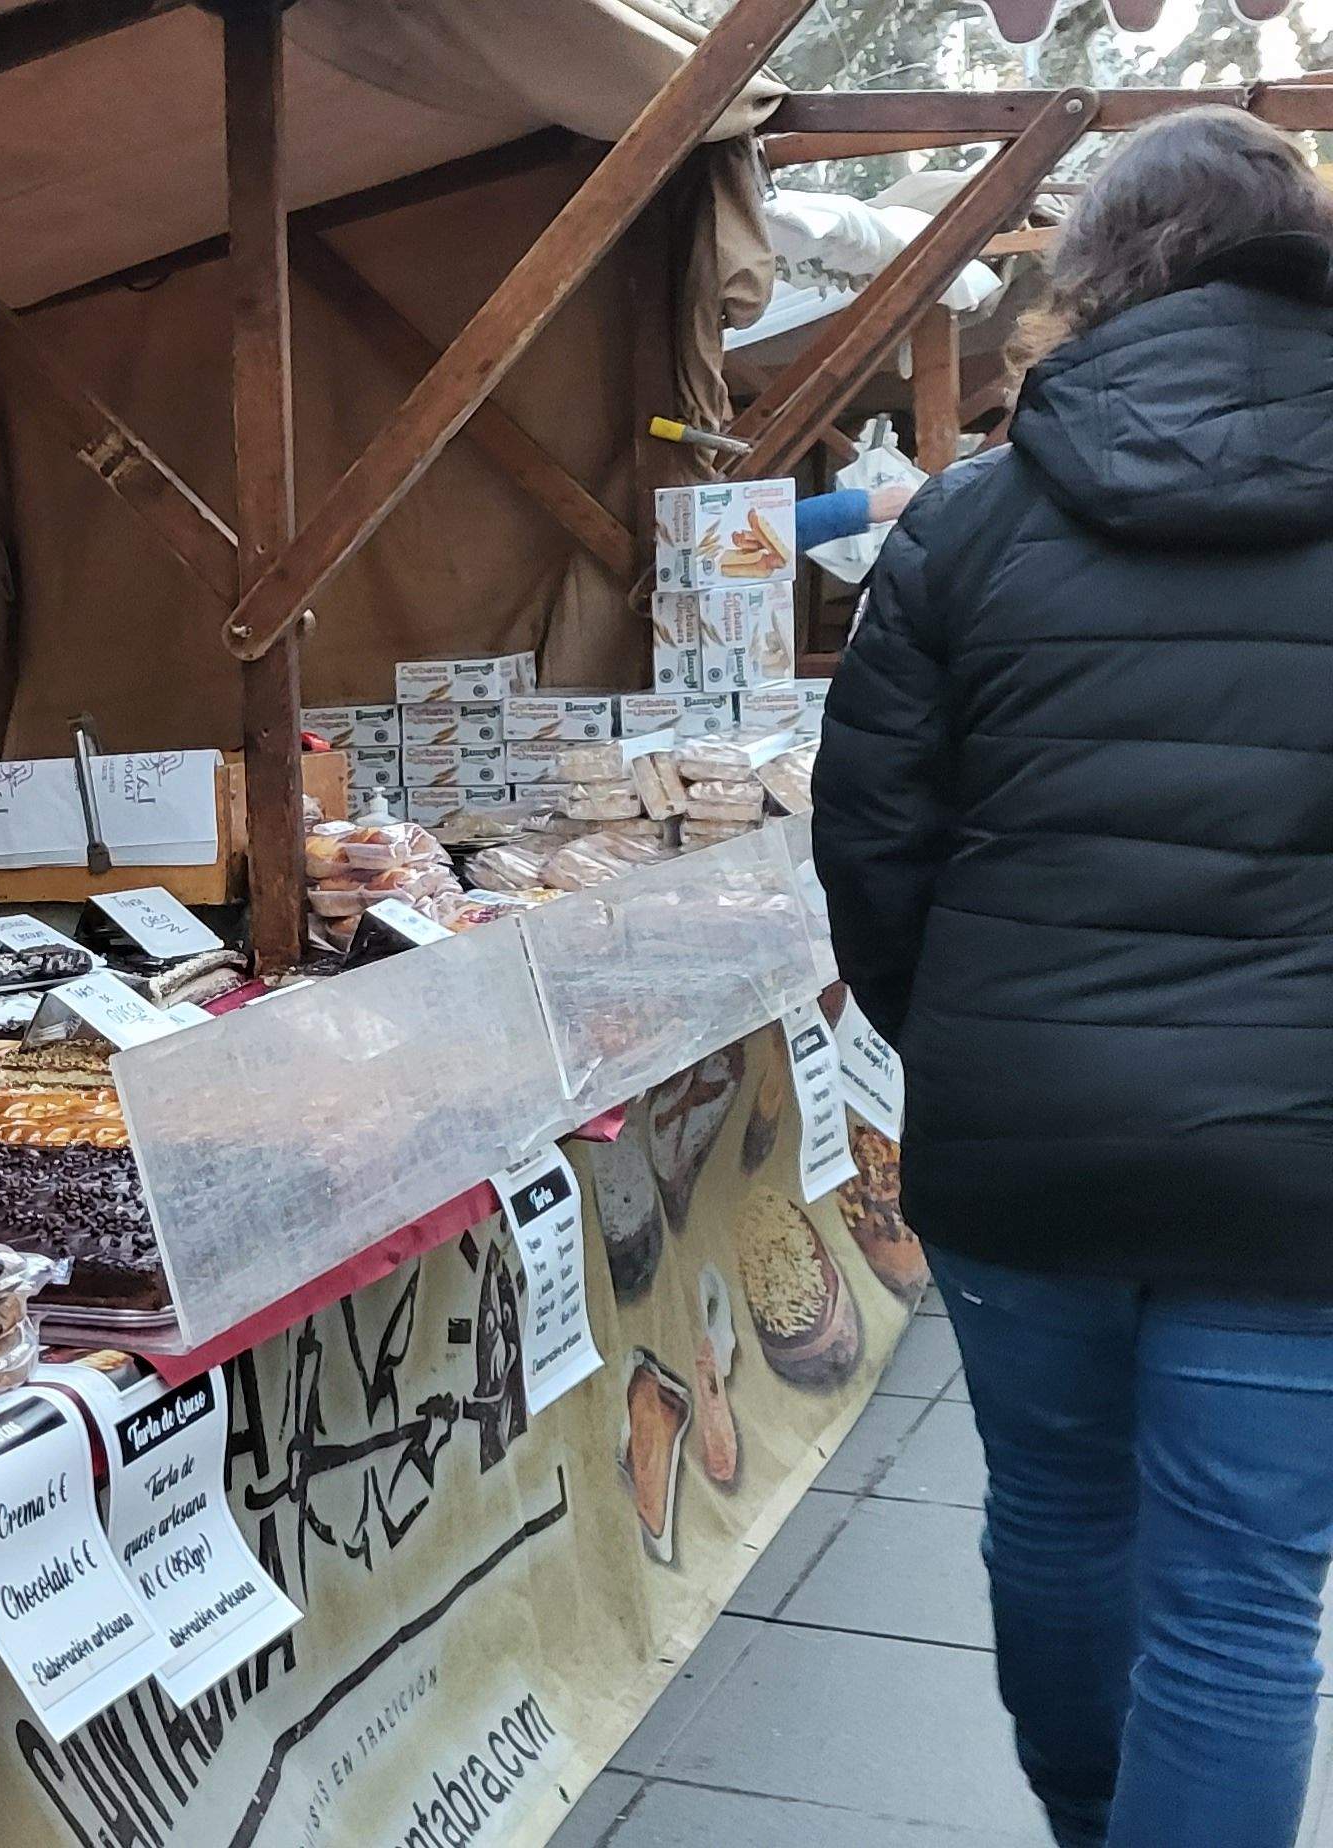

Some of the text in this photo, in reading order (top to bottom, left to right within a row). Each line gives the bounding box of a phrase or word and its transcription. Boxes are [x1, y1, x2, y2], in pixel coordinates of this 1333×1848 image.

[733, 592, 744, 641] Corbatas
[127, 1390, 207, 1452] Tarta de Queso
[181, 1454, 194, 1477] de
[47, 1478, 58, 1508] 6
[59, 1471, 70, 1503] €
[123, 1491, 208, 1568] queso artesana
[70, 1546, 84, 1577] 6
[83, 1538, 98, 1570] €
[216, 1579, 257, 1618] artesana
[32, 1611, 135, 1687] Elaboración artesana
[331, 1752, 355, 1787] EN
[395, 1692, 556, 1848] ntabra.com
